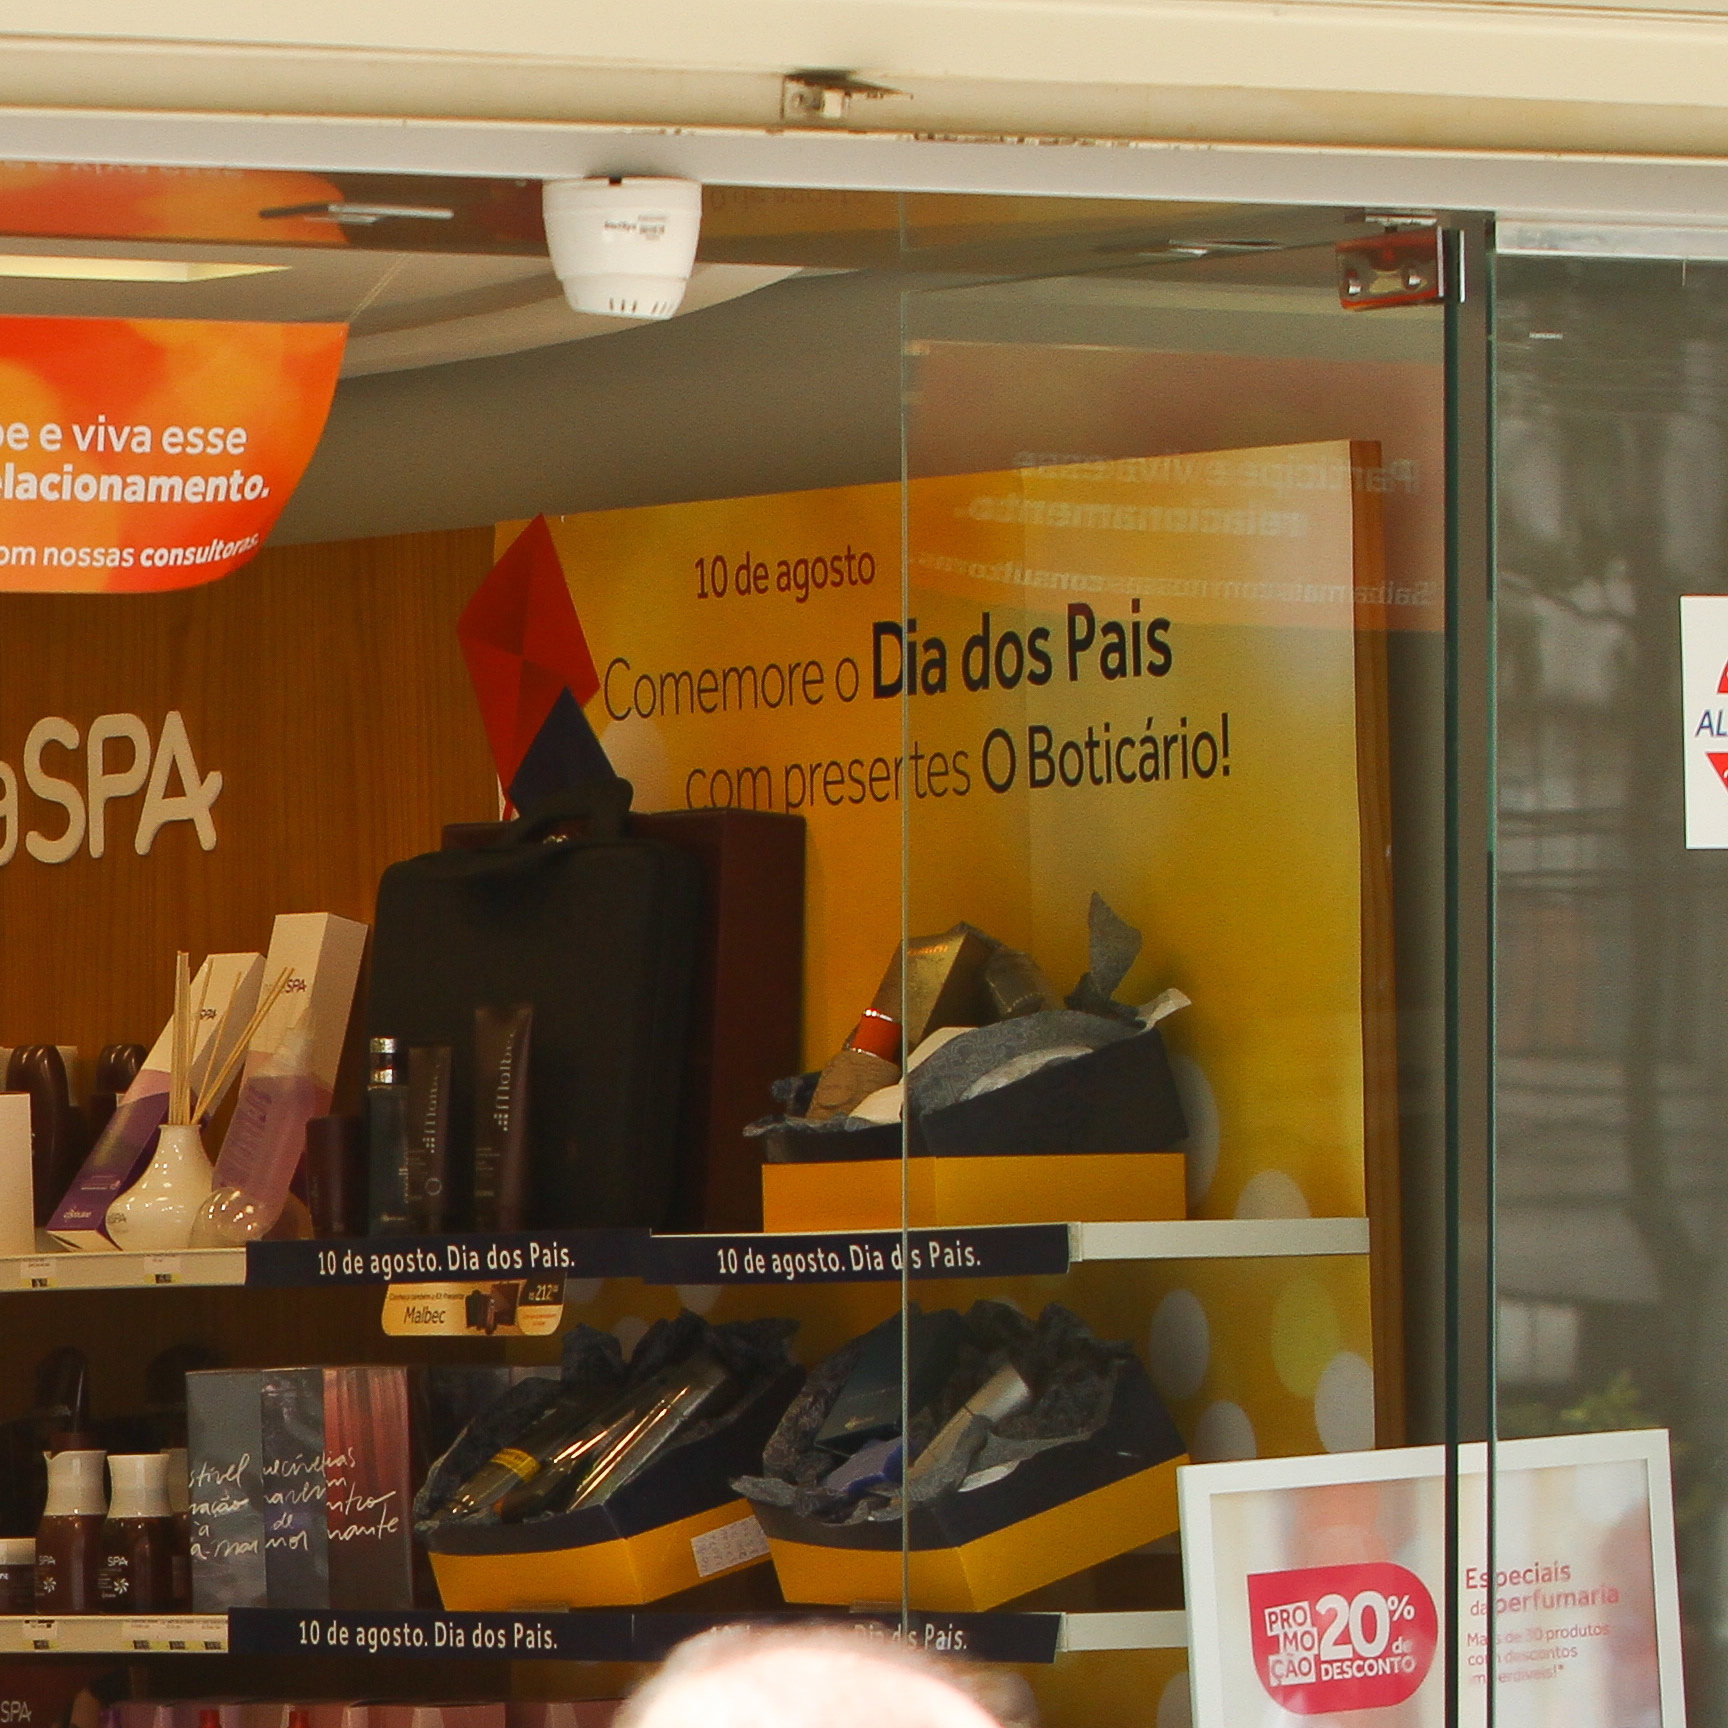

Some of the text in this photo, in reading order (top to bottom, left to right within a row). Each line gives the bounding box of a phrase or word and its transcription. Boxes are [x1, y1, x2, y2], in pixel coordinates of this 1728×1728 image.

[39, 421, 63, 451] e
[72, 414, 153, 455] viva
[161, 425, 249, 456] esse
[42, 545, 135, 568] nossas
[693, 545, 877, 604] 10 de agosto
[604, 598, 1173, 724] Comemore o Dia dos Pais
[686, 757, 774, 810] com
[981, 727, 1016, 795] O
[1027, 712, 1232, 791] Boticário!
[318, 1241, 575, 1281] 10 de agosto. Dia dos Pais.
[717, 1240, 981, 1281] 10 de agosto. Dia ds Pais.
[403, 1306, 446, 1325] Malbec
[1267, 1605, 1309, 1632] PRO
[1315, 1590, 1417, 1661] 20%
[299, 1619, 558, 1653] 10 de agosto. Dia dos Pais.
[924, 1622, 968, 1651] Pais.
[1283, 1630, 1316, 1652] MO
[1391, 1636, 1414, 1654] de
[1467, 1632, 1501, 1648] Mas
[1270, 1652, 1312, 1684] ÇÃO
[1320, 1655, 1417, 1681] DESCONTO
